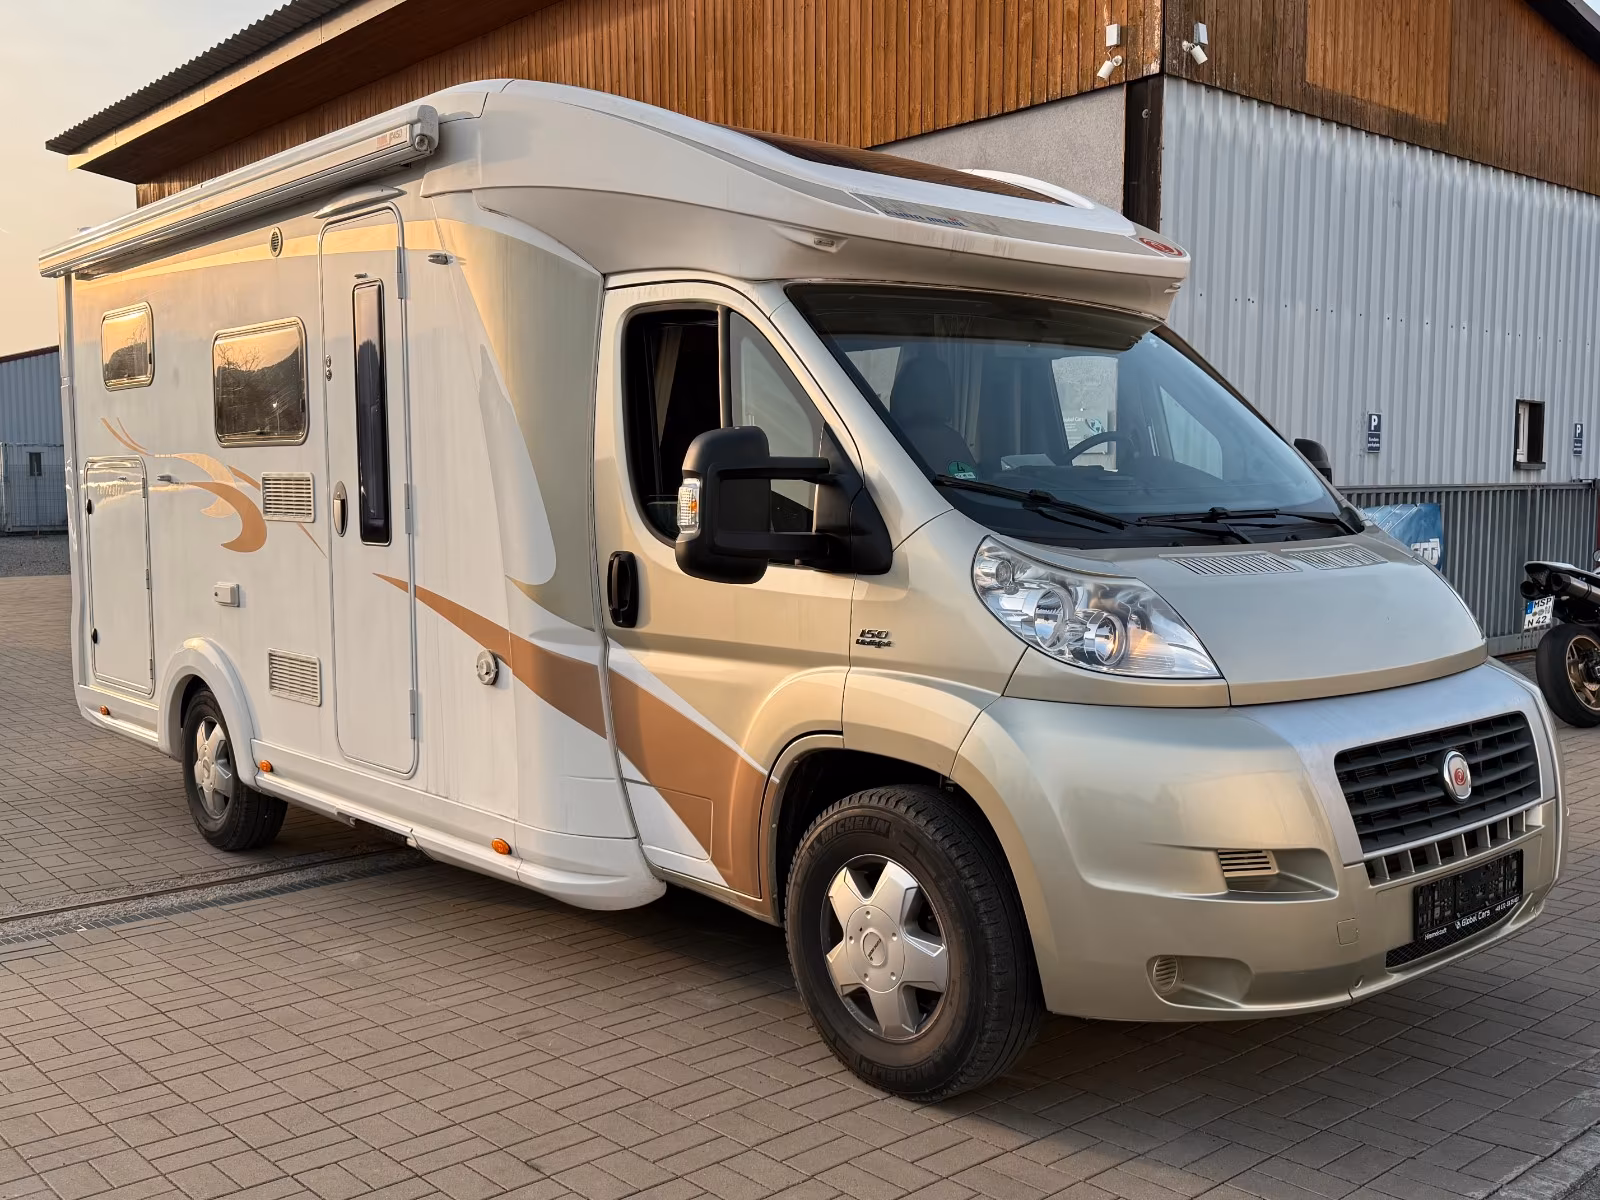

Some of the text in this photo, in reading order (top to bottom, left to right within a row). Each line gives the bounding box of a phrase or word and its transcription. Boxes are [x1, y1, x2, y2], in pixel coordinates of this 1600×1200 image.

[1371, 415, 1379, 430] P
[1576, 424, 1582, 437] P
[956, 462, 965, 472] 4
[1533, 597, 1552, 608] MSP
[1527, 615, 1547, 627] N 42
[859, 628, 889, 639] 150
[820, 814, 893, 845] MICHELIN
[1461, 914, 1478, 927] Global
[1477, 909, 1491, 920] Cars
